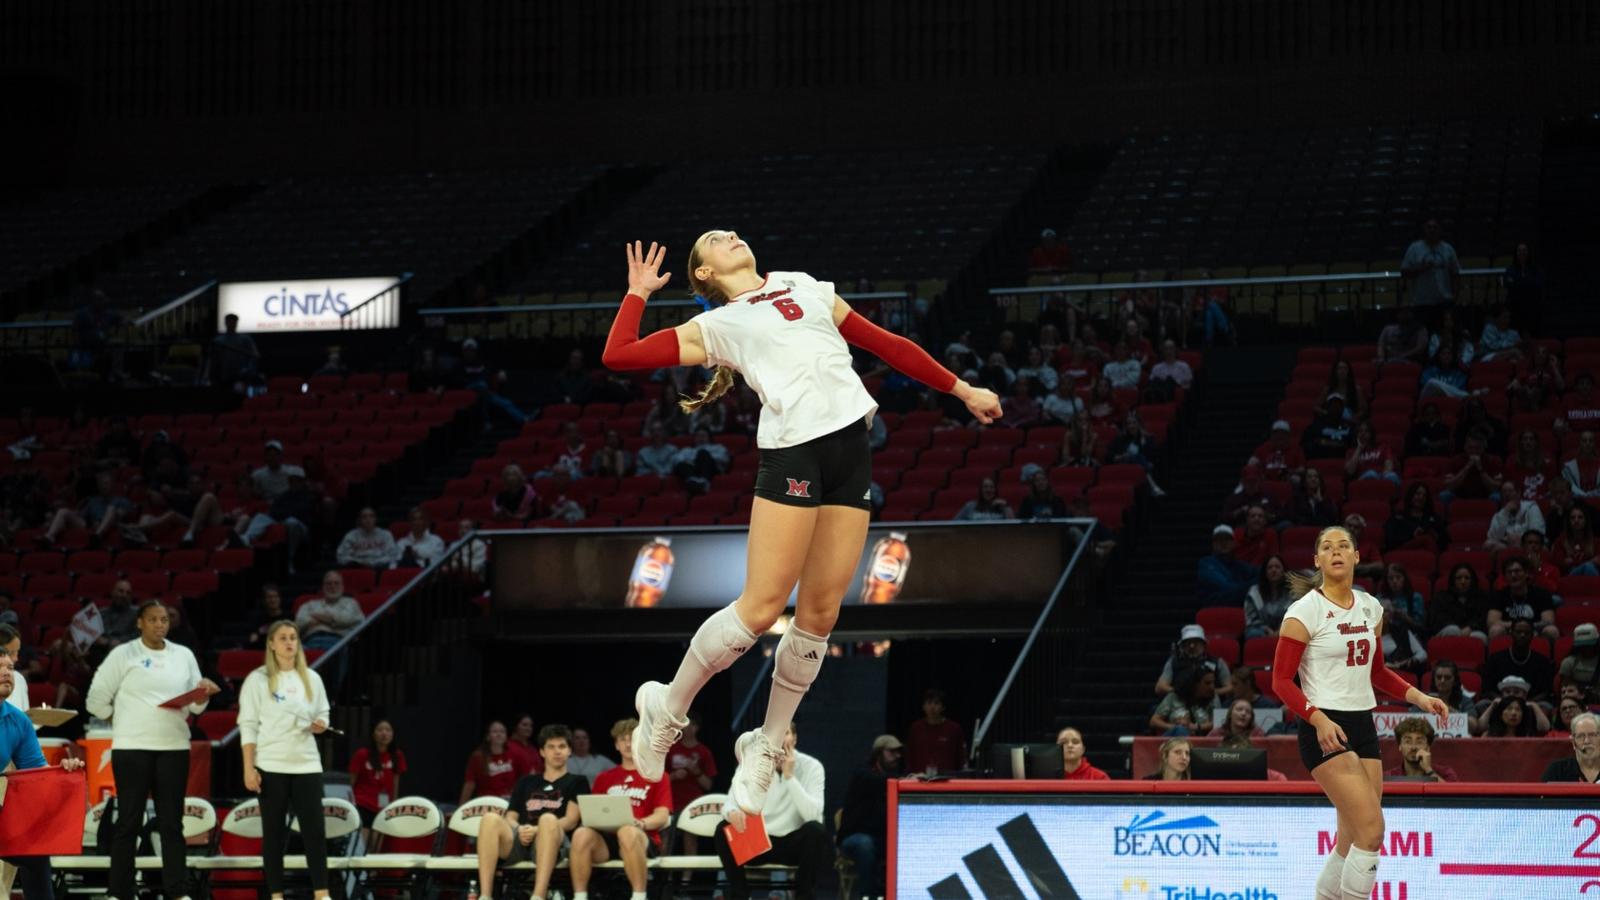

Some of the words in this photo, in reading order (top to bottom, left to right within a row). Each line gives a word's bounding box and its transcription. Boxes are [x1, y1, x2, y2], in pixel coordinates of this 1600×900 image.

[772, 298, 804, 321] 6
[785, 477, 812, 498] M
[1346, 638, 1371, 667] 13
[384, 805, 429, 821] MIAMI
[1113, 827, 1221, 857] BEACON
[1317, 831, 1433, 857] MMI
